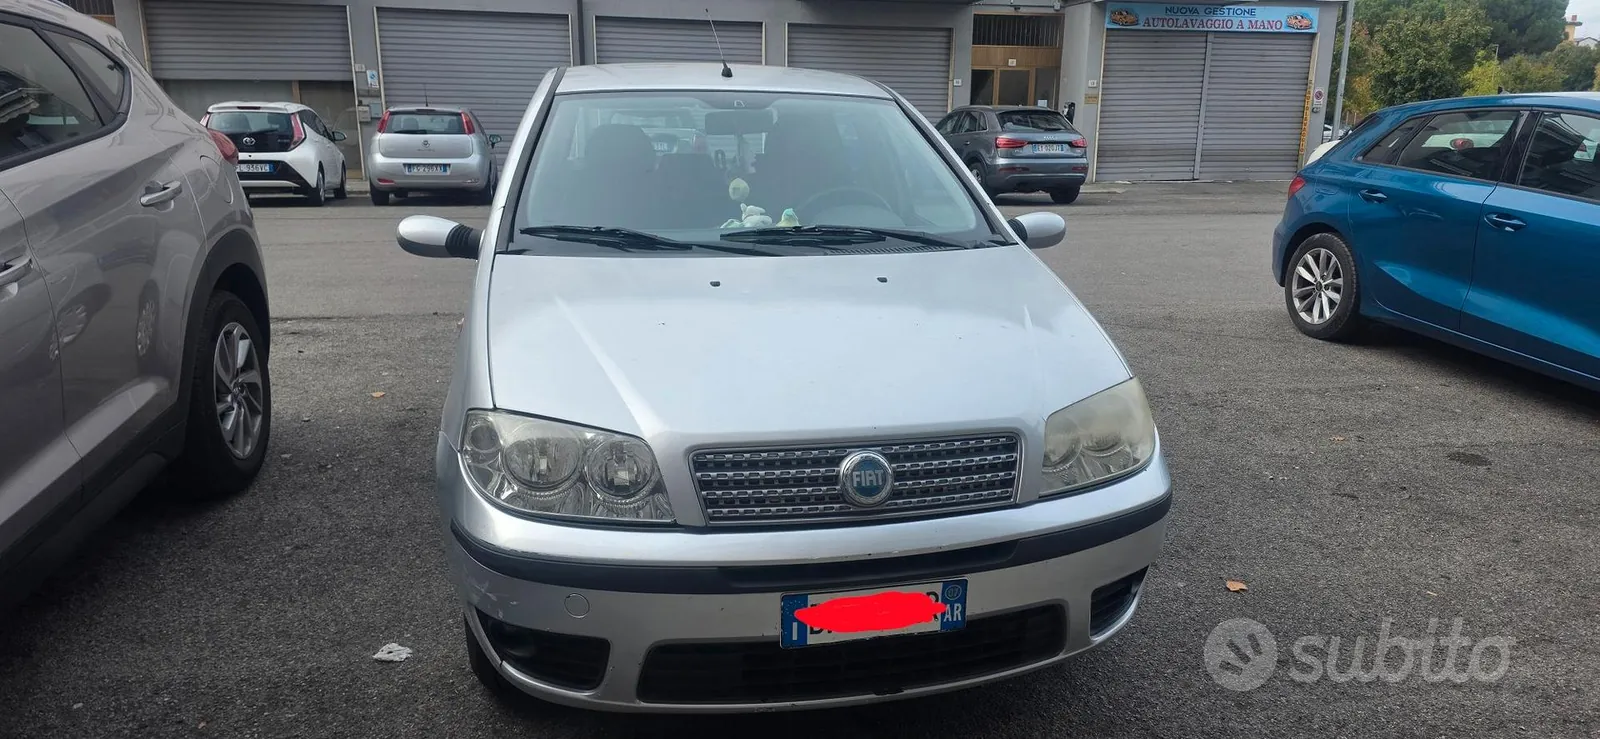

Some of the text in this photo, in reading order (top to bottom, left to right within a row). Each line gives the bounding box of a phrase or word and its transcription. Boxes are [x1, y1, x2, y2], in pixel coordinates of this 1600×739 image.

[1165, 6, 1256, 16] NUOVA GESTIONE
[1142, 17, 1283, 31] AUTOLAVAGGIO A MANO
[852, 469, 883, 486] FIAT
[943, 603, 962, 622] AR
